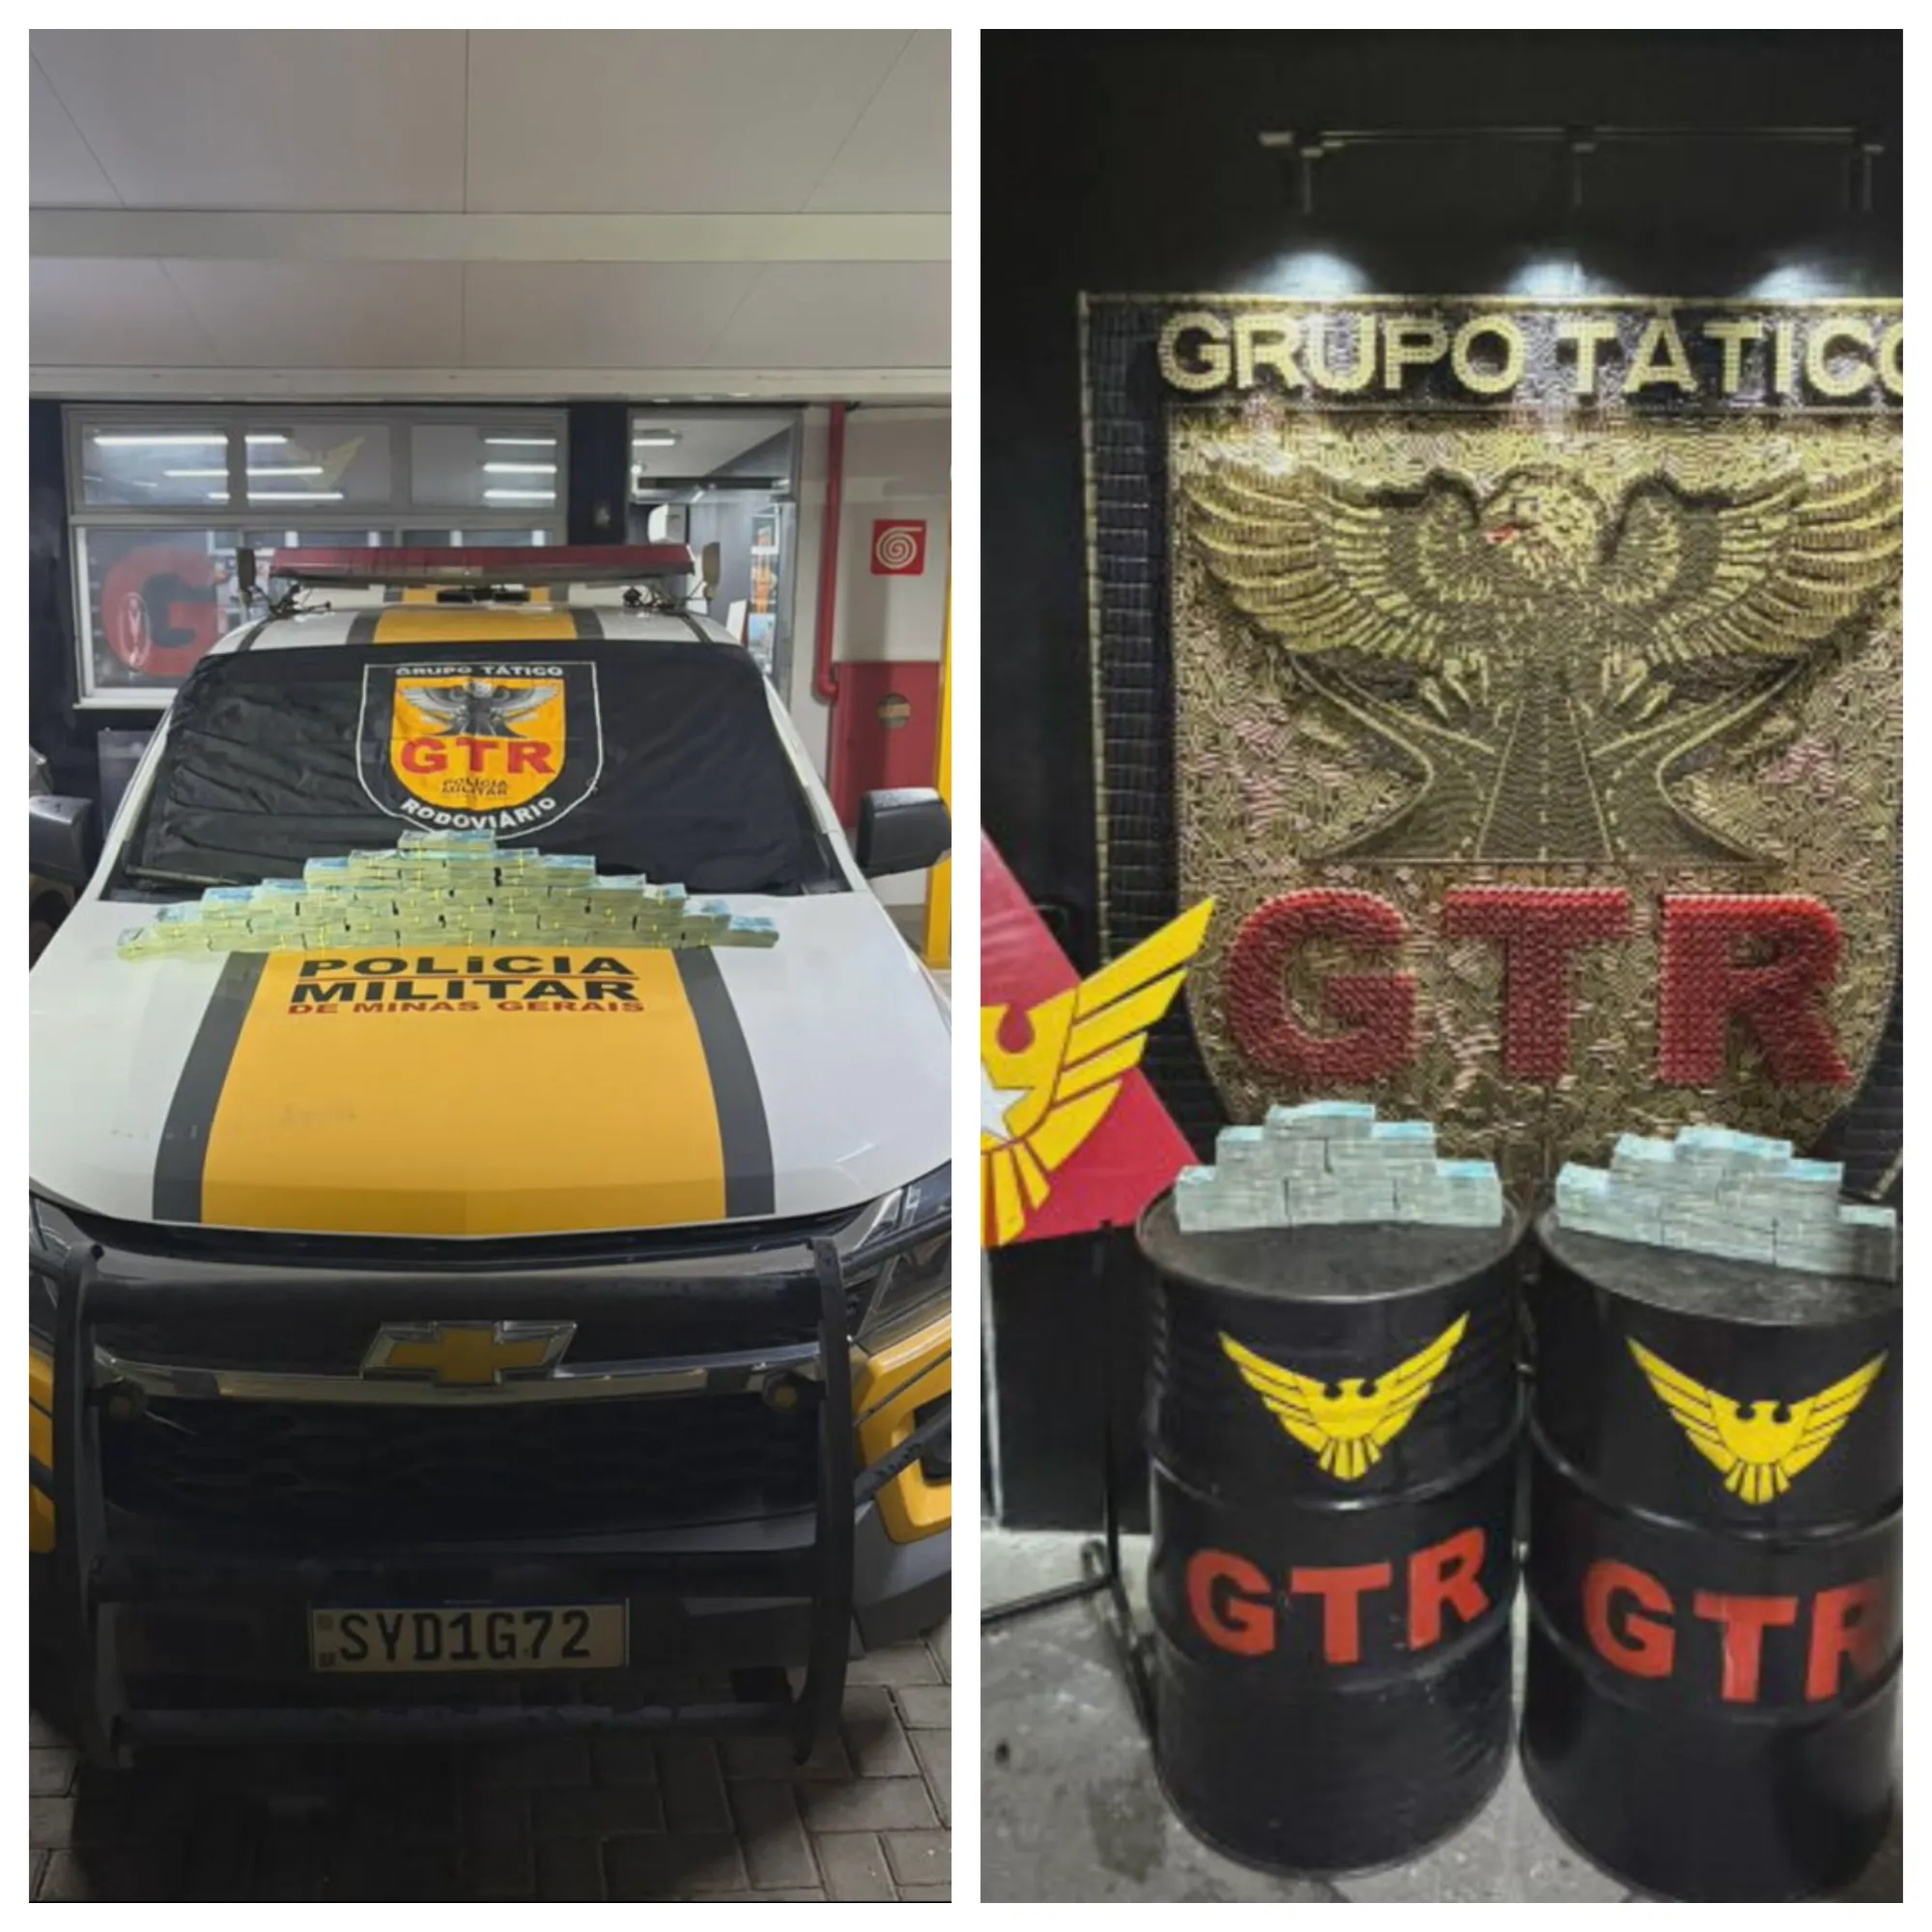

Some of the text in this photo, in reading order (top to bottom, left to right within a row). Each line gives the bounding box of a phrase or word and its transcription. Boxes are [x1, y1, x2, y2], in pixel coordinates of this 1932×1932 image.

[1160, 311, 1527, 393] GRUPO
[395, 666, 472, 676] GRUPO
[401, 737, 556, 775] GTR
[400, 796, 556, 830] RODOVIÁRIO
[288, 1000, 645, 1014] DE MINAS GERAIS
[291, 979, 639, 1003] MILITAR
[1224, 885, 1855, 1086] GTR
[1185, 1526, 1490, 1664] GTR
[339, 1608, 591, 1662] SYD1G72
[1581, 1559, 1889, 1703] GTR
